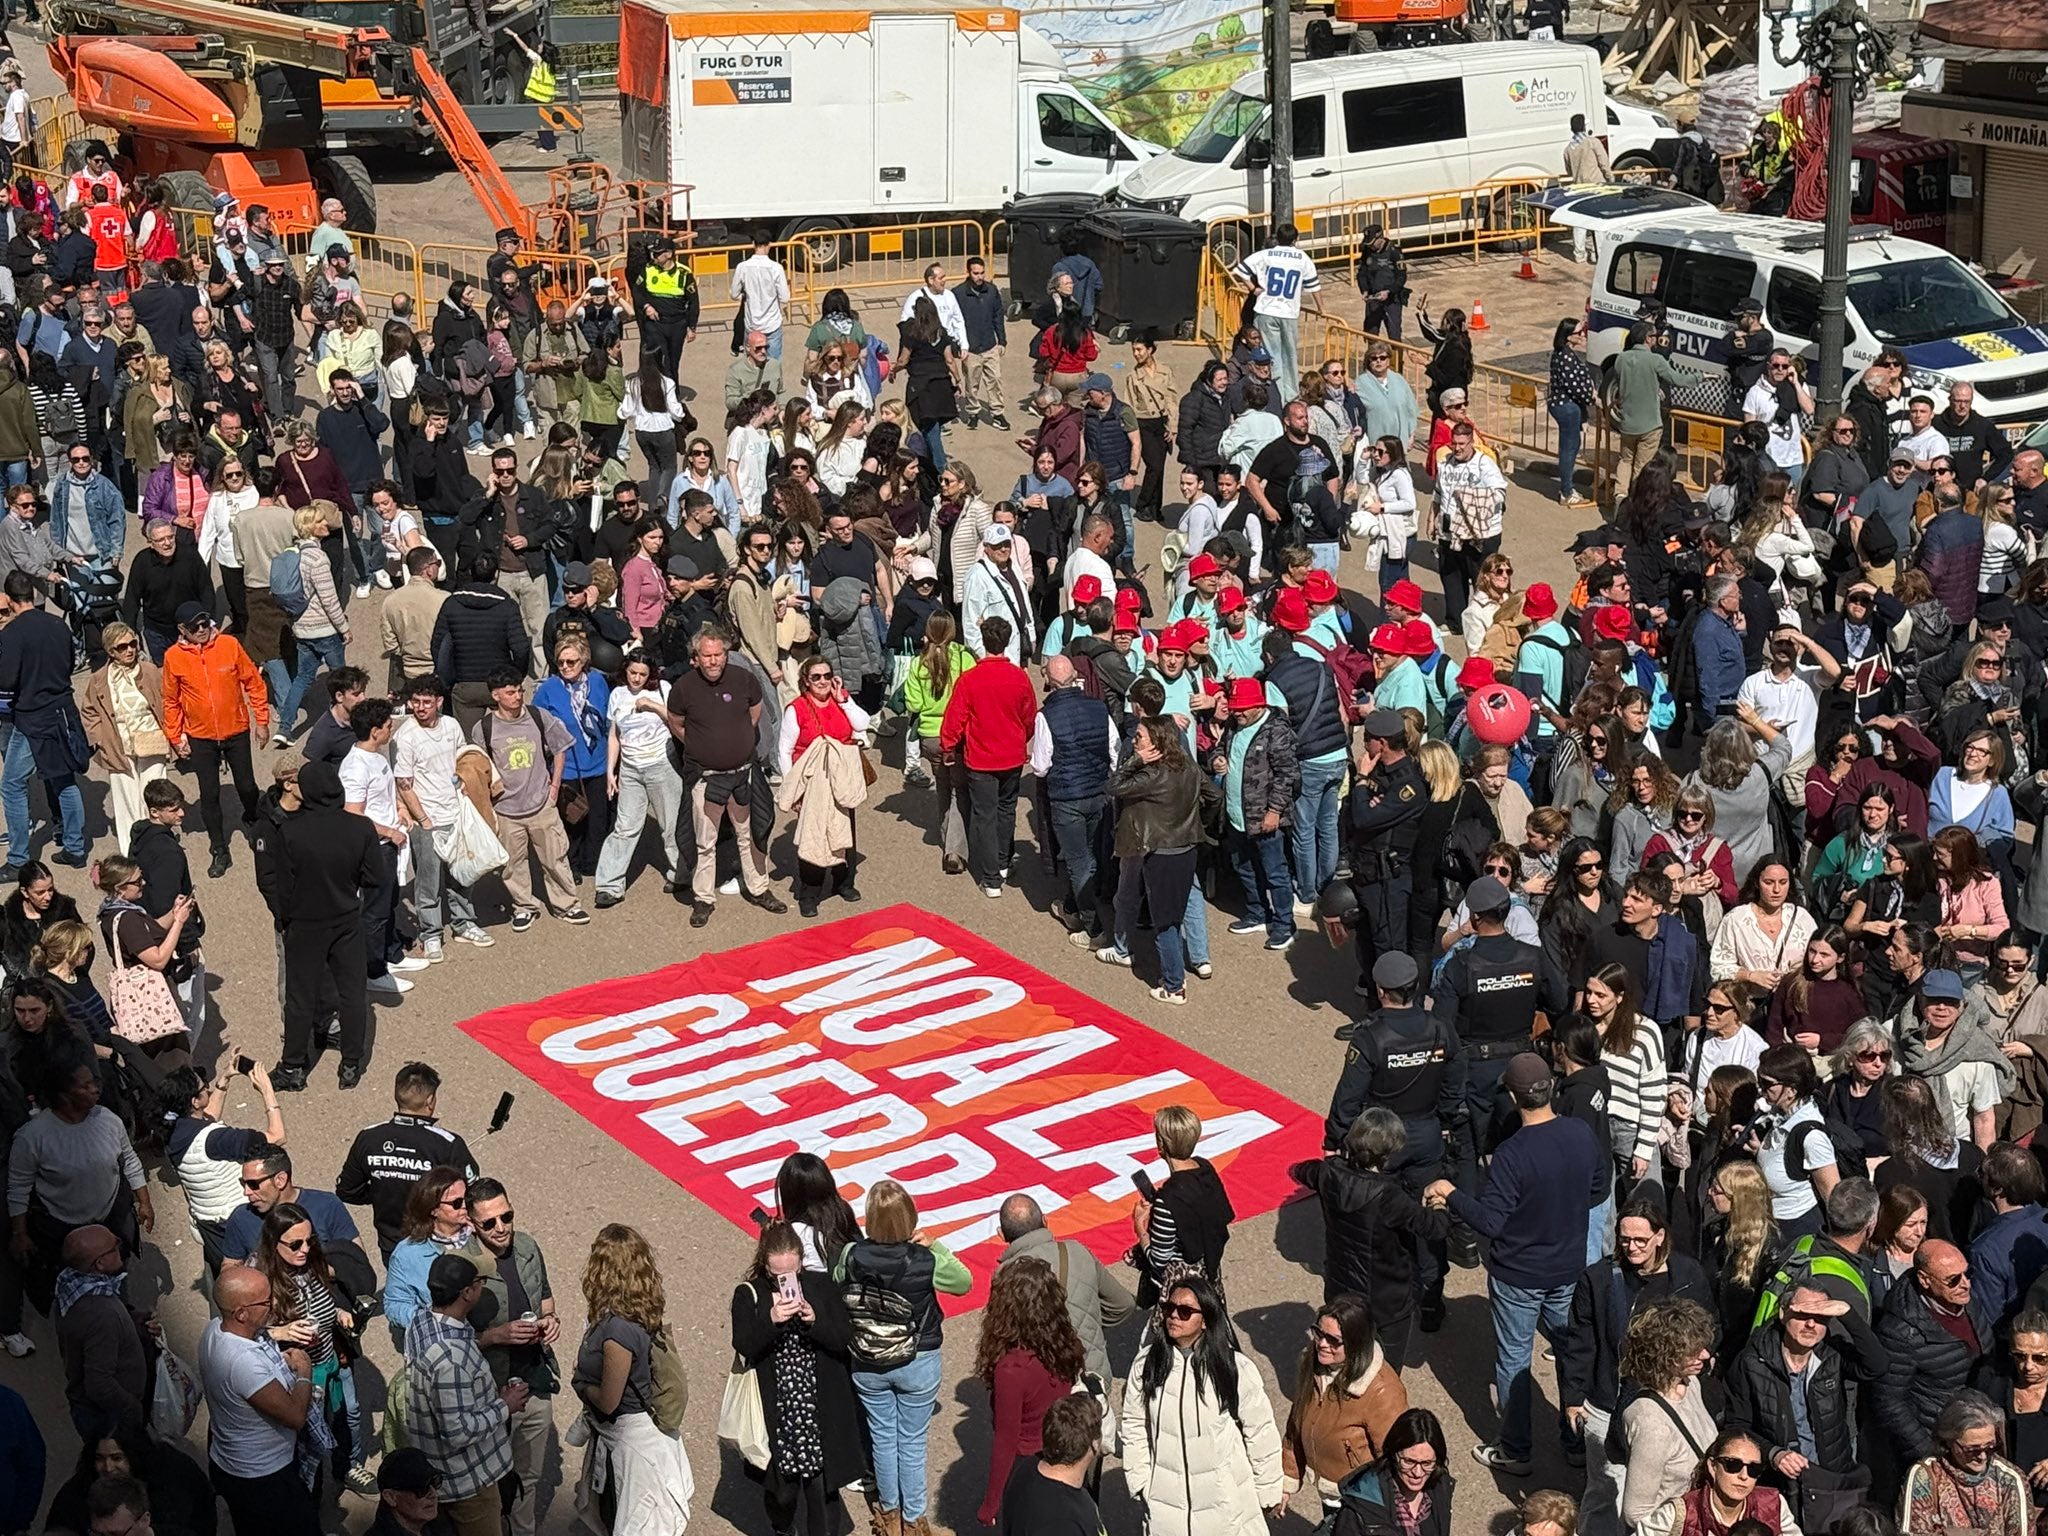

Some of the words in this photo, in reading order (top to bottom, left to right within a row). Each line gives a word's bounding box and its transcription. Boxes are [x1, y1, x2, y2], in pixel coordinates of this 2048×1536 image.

[755, 55, 783, 67] TUR
[738, 81, 774, 91] Reservas
[1531, 77, 1549, 90] Art
[738, 90, 750, 100] 96
[751, 90, 766, 99] 122
[1530, 89, 1577, 103] Factory
[1981, 122, 2048, 147] MONTAÑA
[1918, 184, 1939, 200] 112
[1611, 233, 1624, 242] 092
[1268, 250, 1303, 260] BUFFALO
[1267, 266, 1301, 300] 60
[1593, 299, 1613, 310] POLICIA
[1614, 303, 1631, 315] LOCAL
[1667, 311, 1686, 321] NITAT
[1709, 321, 1719, 330] DE
[1676, 332, 1710, 357] PLV
[1477, 974, 1522, 986] POLICIA
[1477, 980, 1534, 993] NACIONAL
[746, 936, 1027, 1046] NO
[1387, 1050, 1432, 1062] POLICIA
[1387, 1055, 1444, 1069] NACIONAL
[888, 1024, 1120, 1108] A
[985, 1068, 1285, 1203] LA
[367, 1155, 432, 1171] PETRONAS
[372, 1170, 422, 1181] CROWDSTRI
